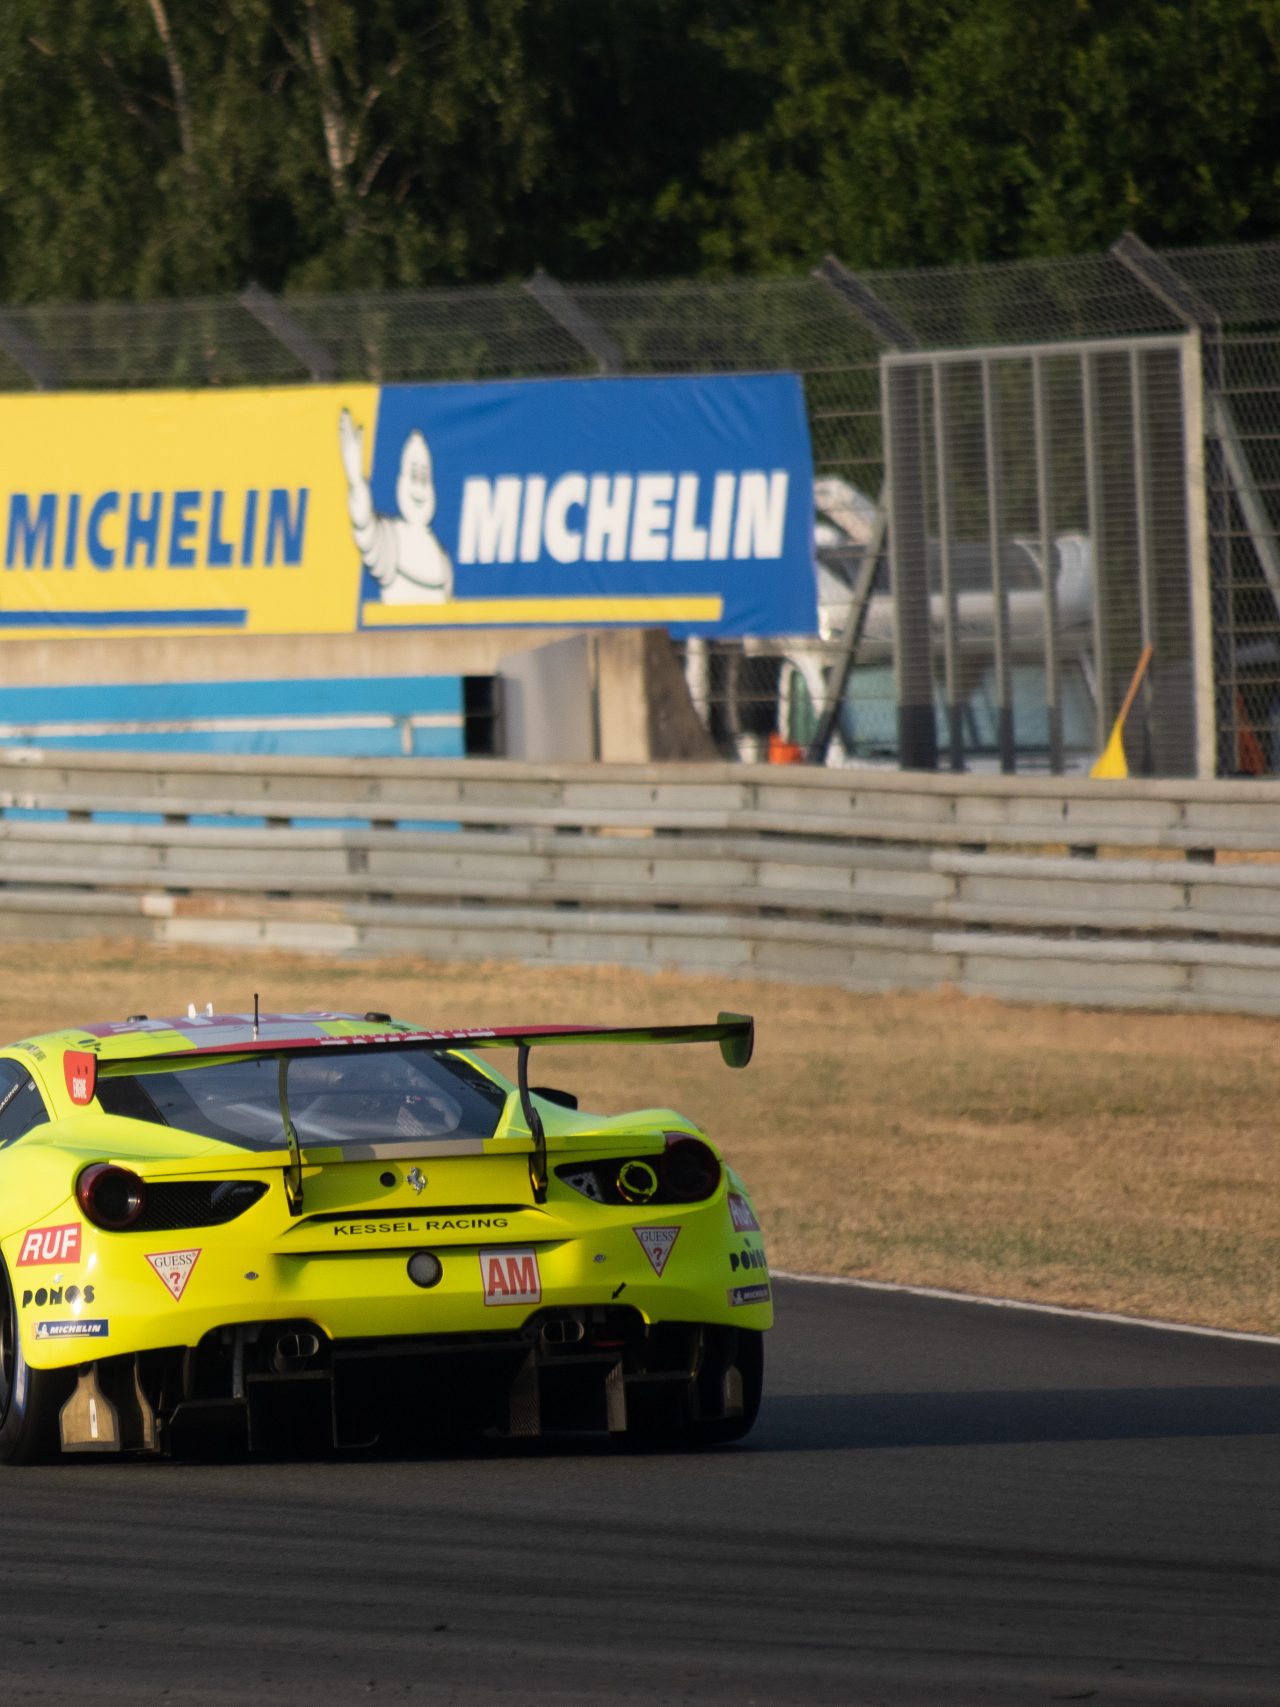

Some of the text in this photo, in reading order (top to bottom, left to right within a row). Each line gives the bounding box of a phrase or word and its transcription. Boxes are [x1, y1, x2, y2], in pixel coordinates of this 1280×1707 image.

[4, 488, 308, 571] MICHELIN
[457, 470, 788, 564] MICHELIN
[333, 1218, 508, 1236] KESSEL RACING
[21, 1228, 78, 1262] RUF
[154, 1254, 193, 1268] GUESS
[487, 1256, 537, 1296] AM
[22, 1284, 96, 1309] PONOS
[49, 1324, 101, 1335] MICHELIN
